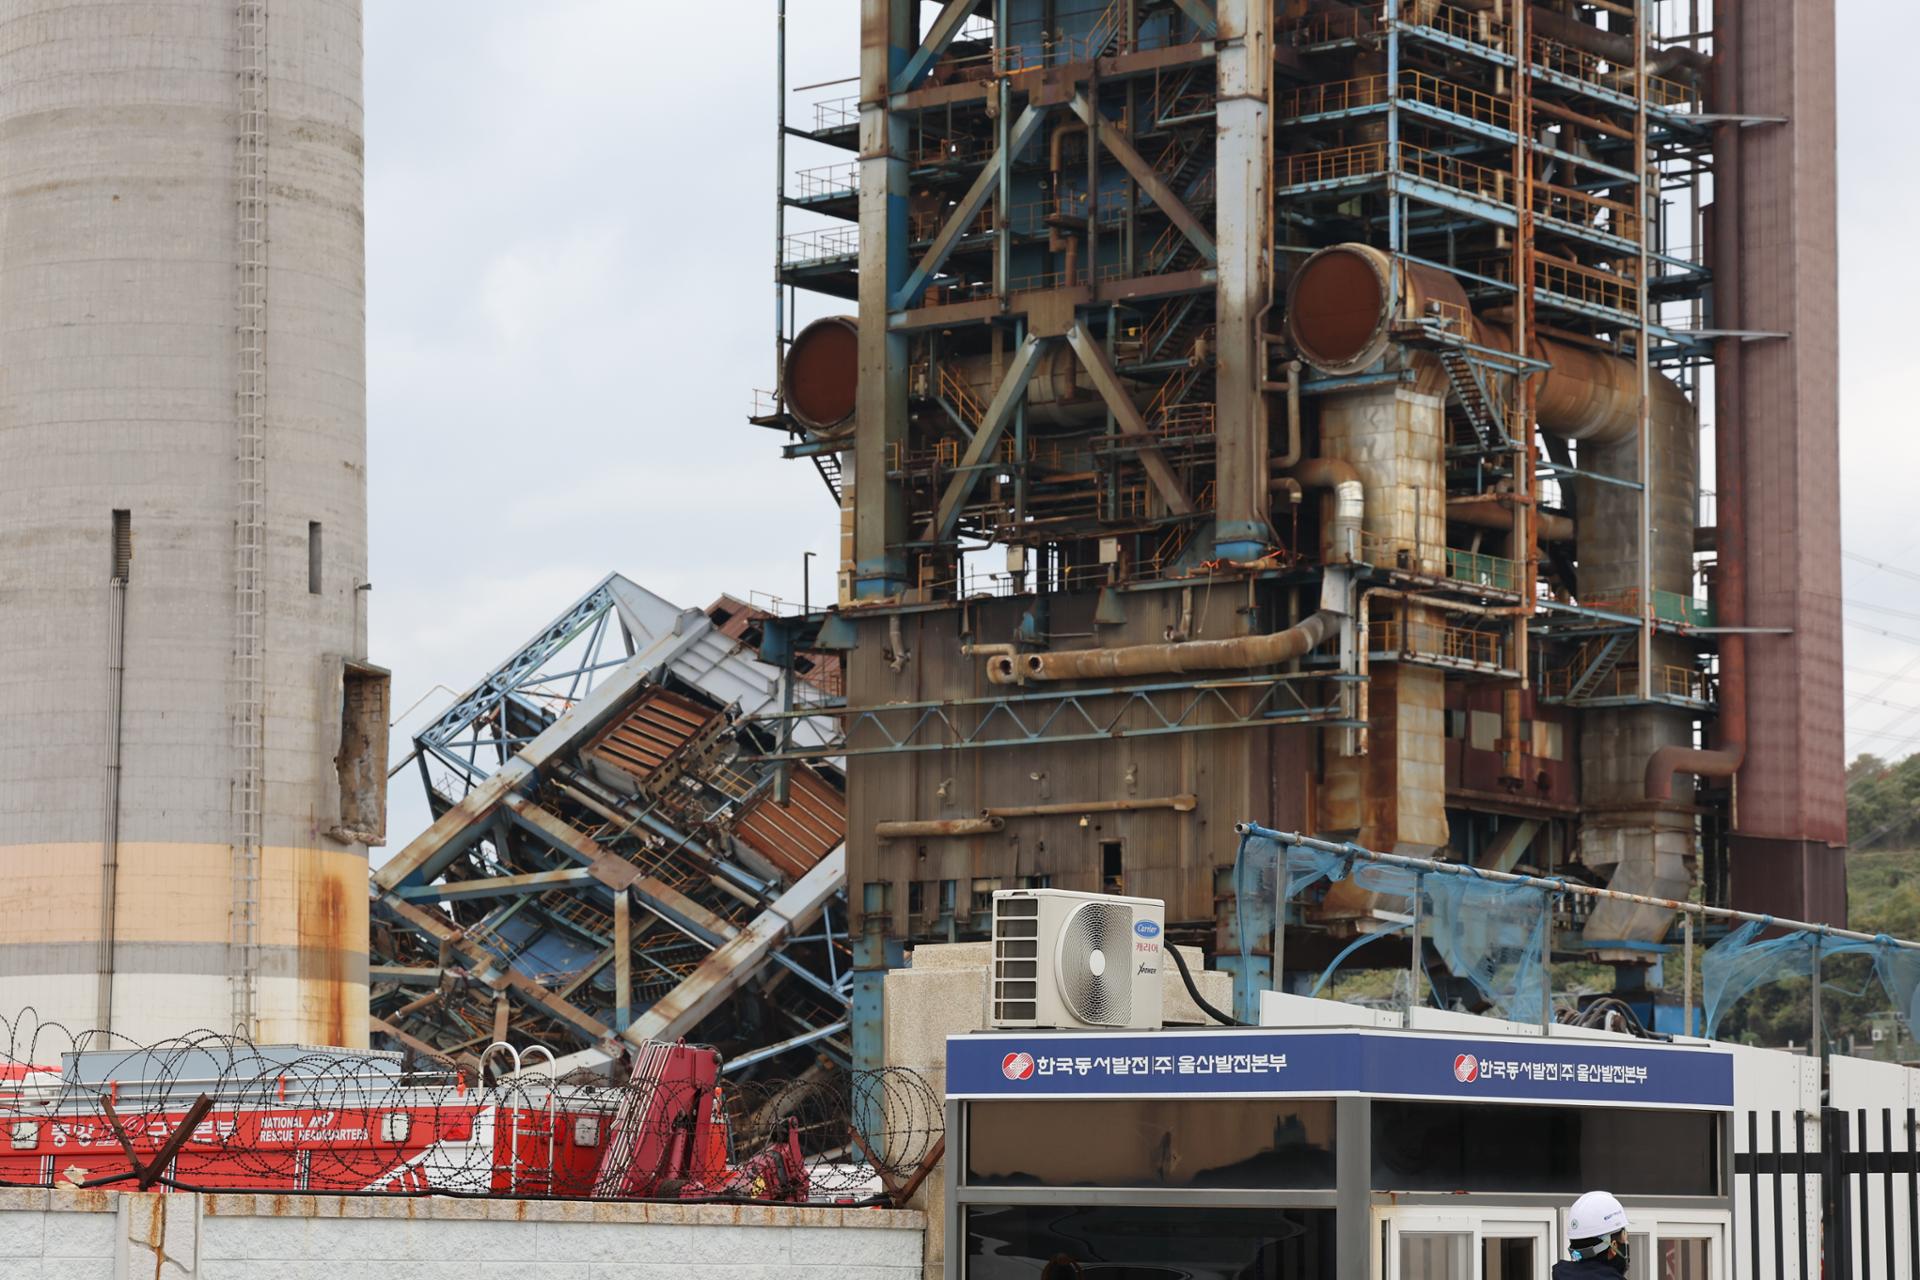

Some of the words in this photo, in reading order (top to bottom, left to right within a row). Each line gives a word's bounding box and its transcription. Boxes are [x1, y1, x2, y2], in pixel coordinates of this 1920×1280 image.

[1137, 923, 1157, 933] Carrier
[260, 1116, 304, 1129] NATIONAL
[260, 1130, 294, 1142] RESCUE
